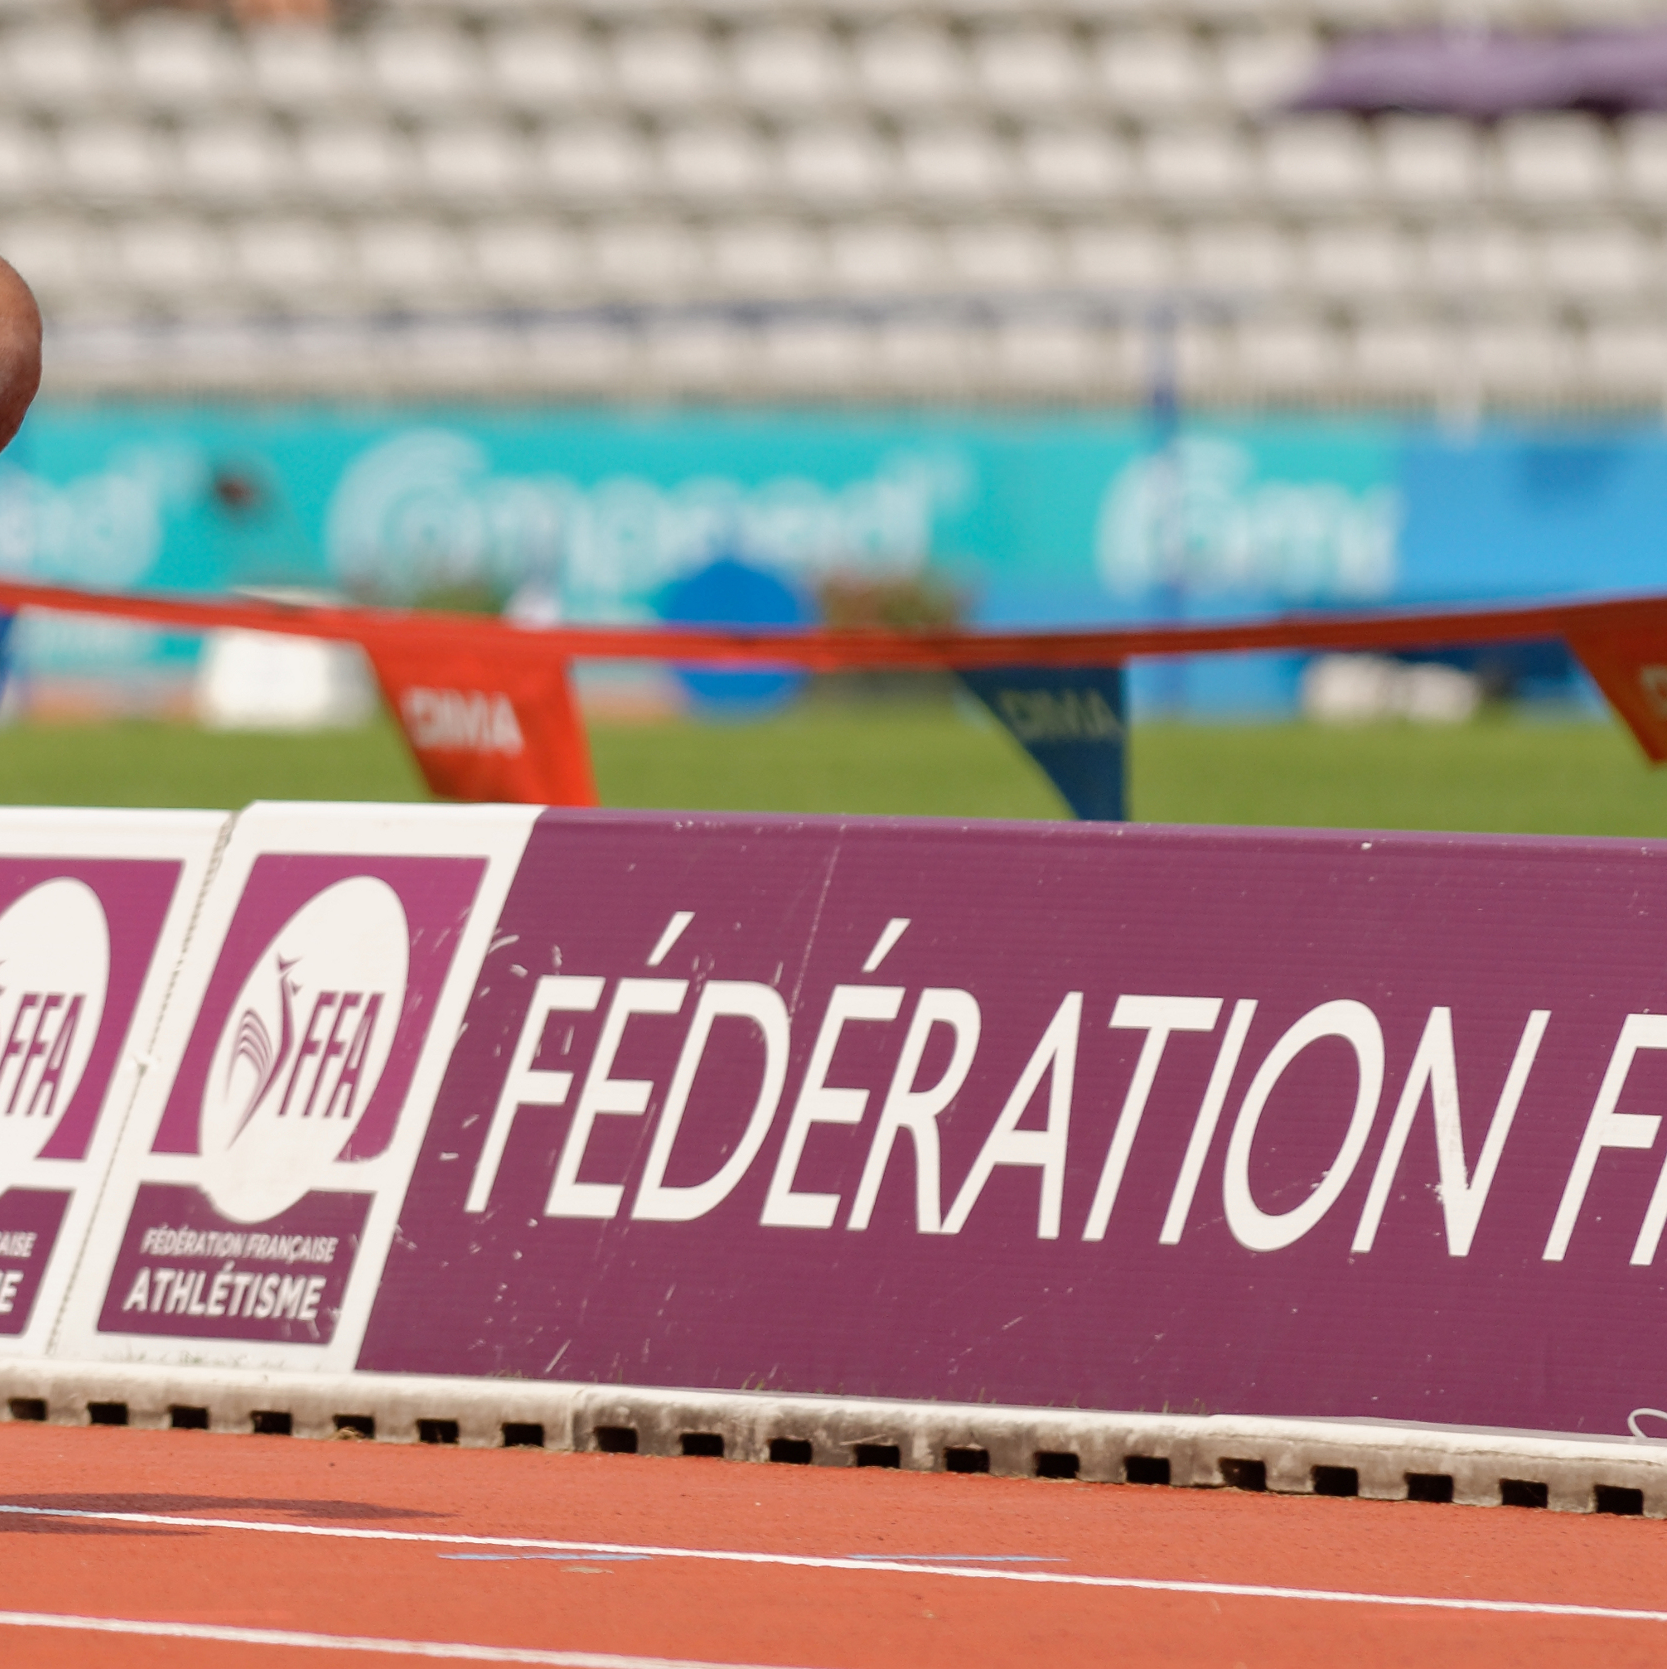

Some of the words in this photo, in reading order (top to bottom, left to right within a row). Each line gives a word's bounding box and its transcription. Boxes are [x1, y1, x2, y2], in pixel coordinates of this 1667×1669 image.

[463, 910, 1552, 1258] FÉDÉRATION
[1542, 1013, 1667, 1267] F
[140, 1221, 245, 1258] FÉDÉRATION
[244, 1232, 340, 1265] FRANÇAISE
[122, 1259, 327, 1321] ATHLÉTISME
